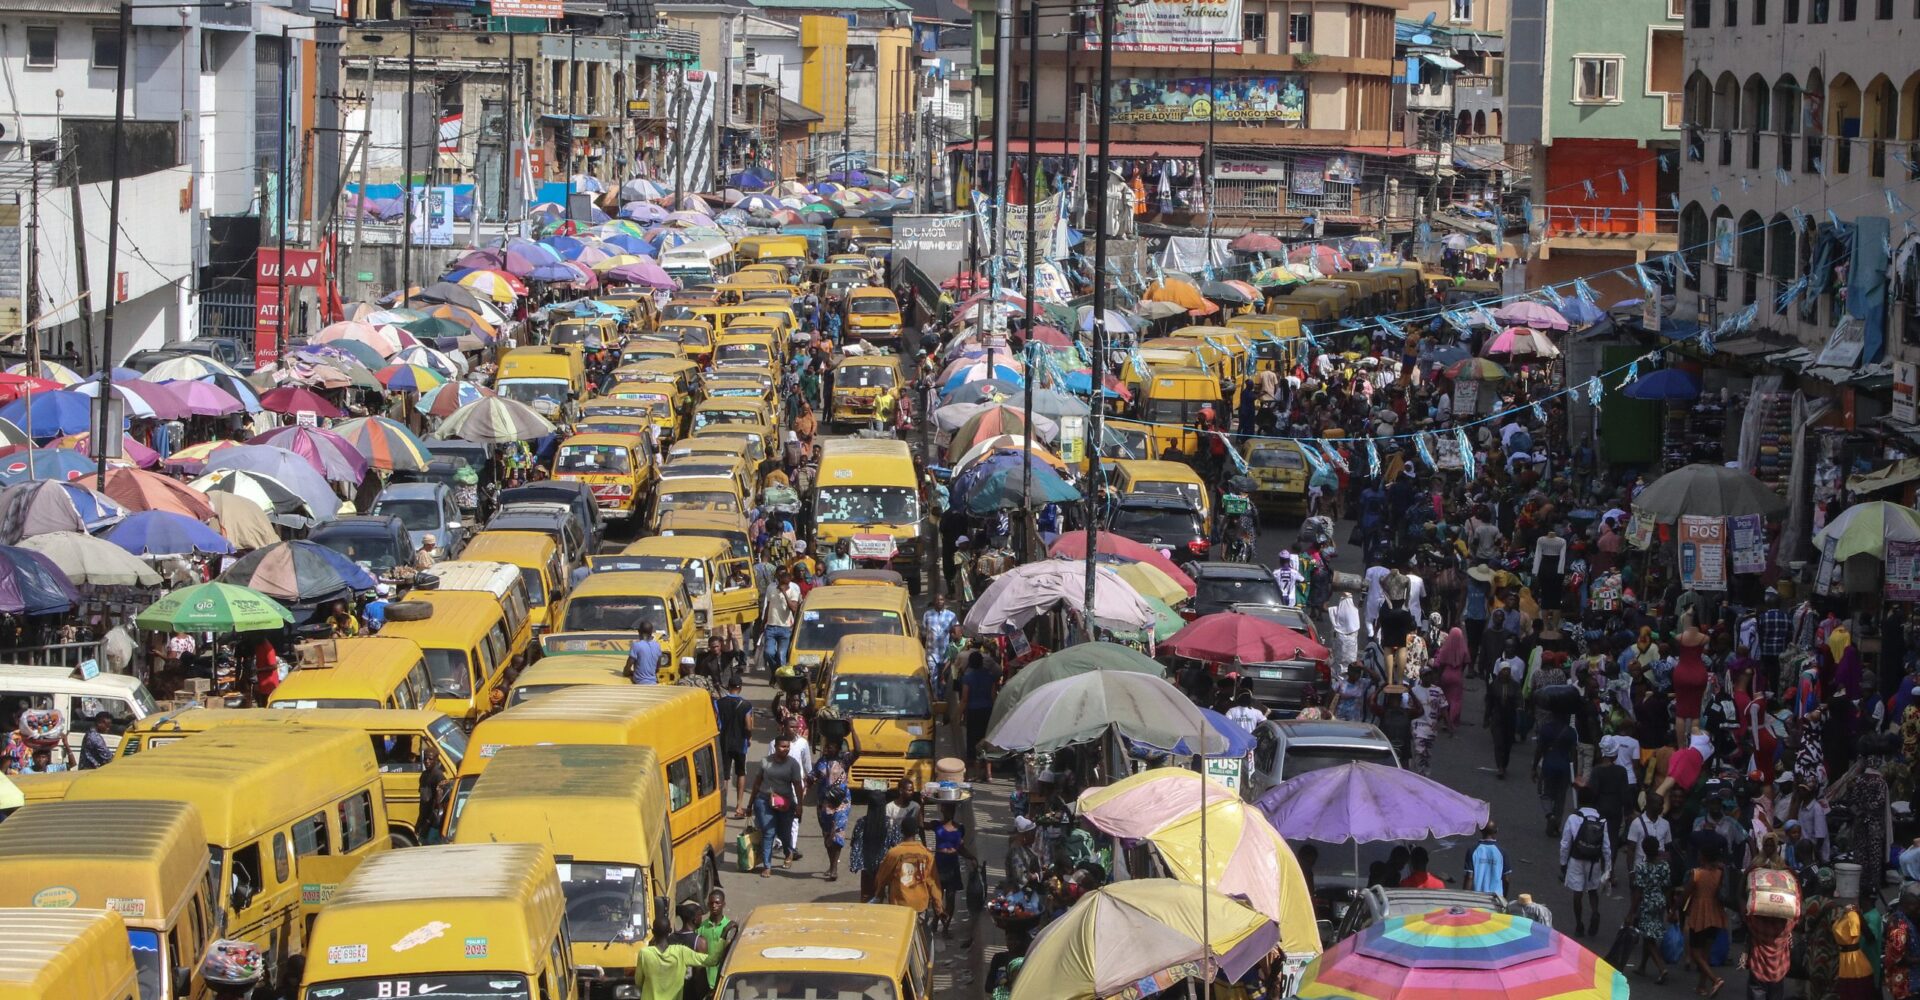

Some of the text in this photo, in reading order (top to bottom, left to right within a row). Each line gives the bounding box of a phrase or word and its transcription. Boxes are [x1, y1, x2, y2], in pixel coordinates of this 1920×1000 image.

[1182, 6, 1228, 18] Fabrics
[1118, 113, 1135, 121] GET
[1226, 110, 1261, 118] GONGO
[902, 227, 947, 238] IDUMOTA
[1689, 525, 1719, 538] POS
[196, 601, 213, 610] glo
[1208, 758, 1239, 770] POS
[466, 944, 487, 956] 2023
